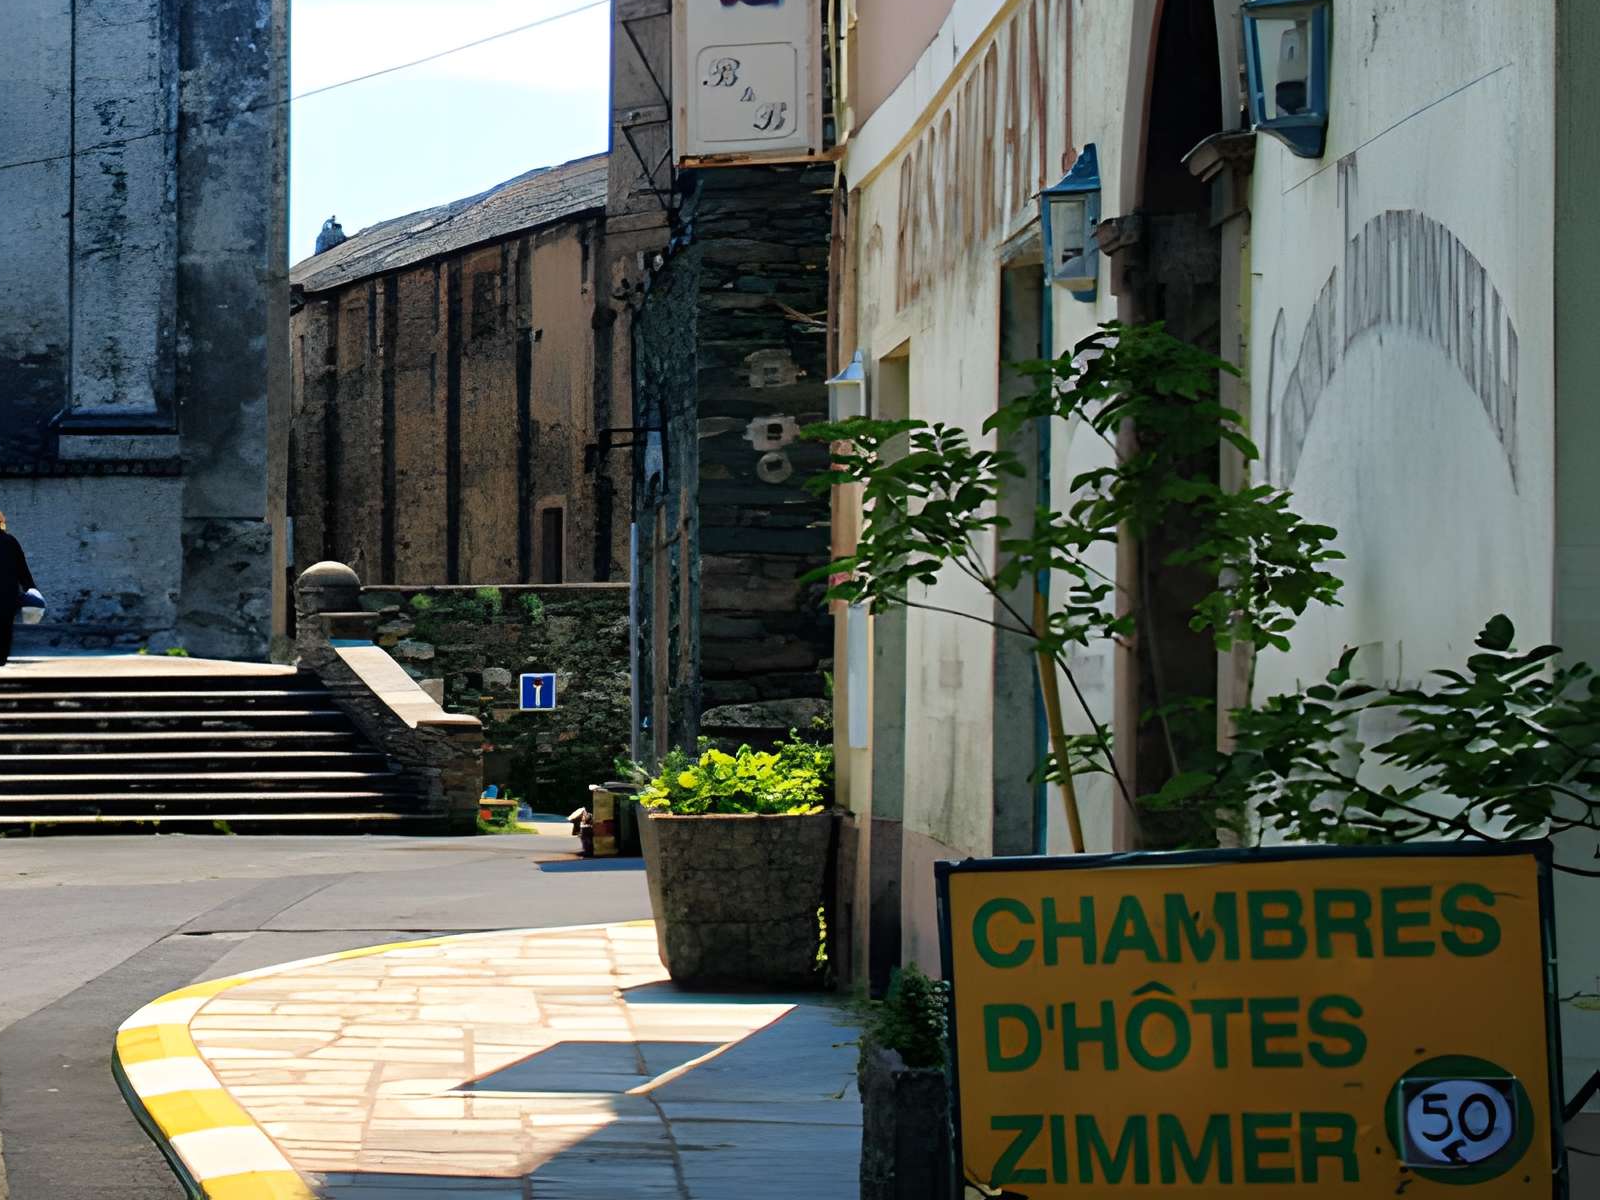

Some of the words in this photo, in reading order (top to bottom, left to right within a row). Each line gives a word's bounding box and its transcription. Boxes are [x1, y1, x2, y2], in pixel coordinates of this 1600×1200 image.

[972, 882, 1501, 969] CHAMBRES
[982, 980, 1368, 1073] D'HÔTES
[988, 1112, 1361, 1186] ZIMMER
[1421, 1092, 1497, 1142] 50
